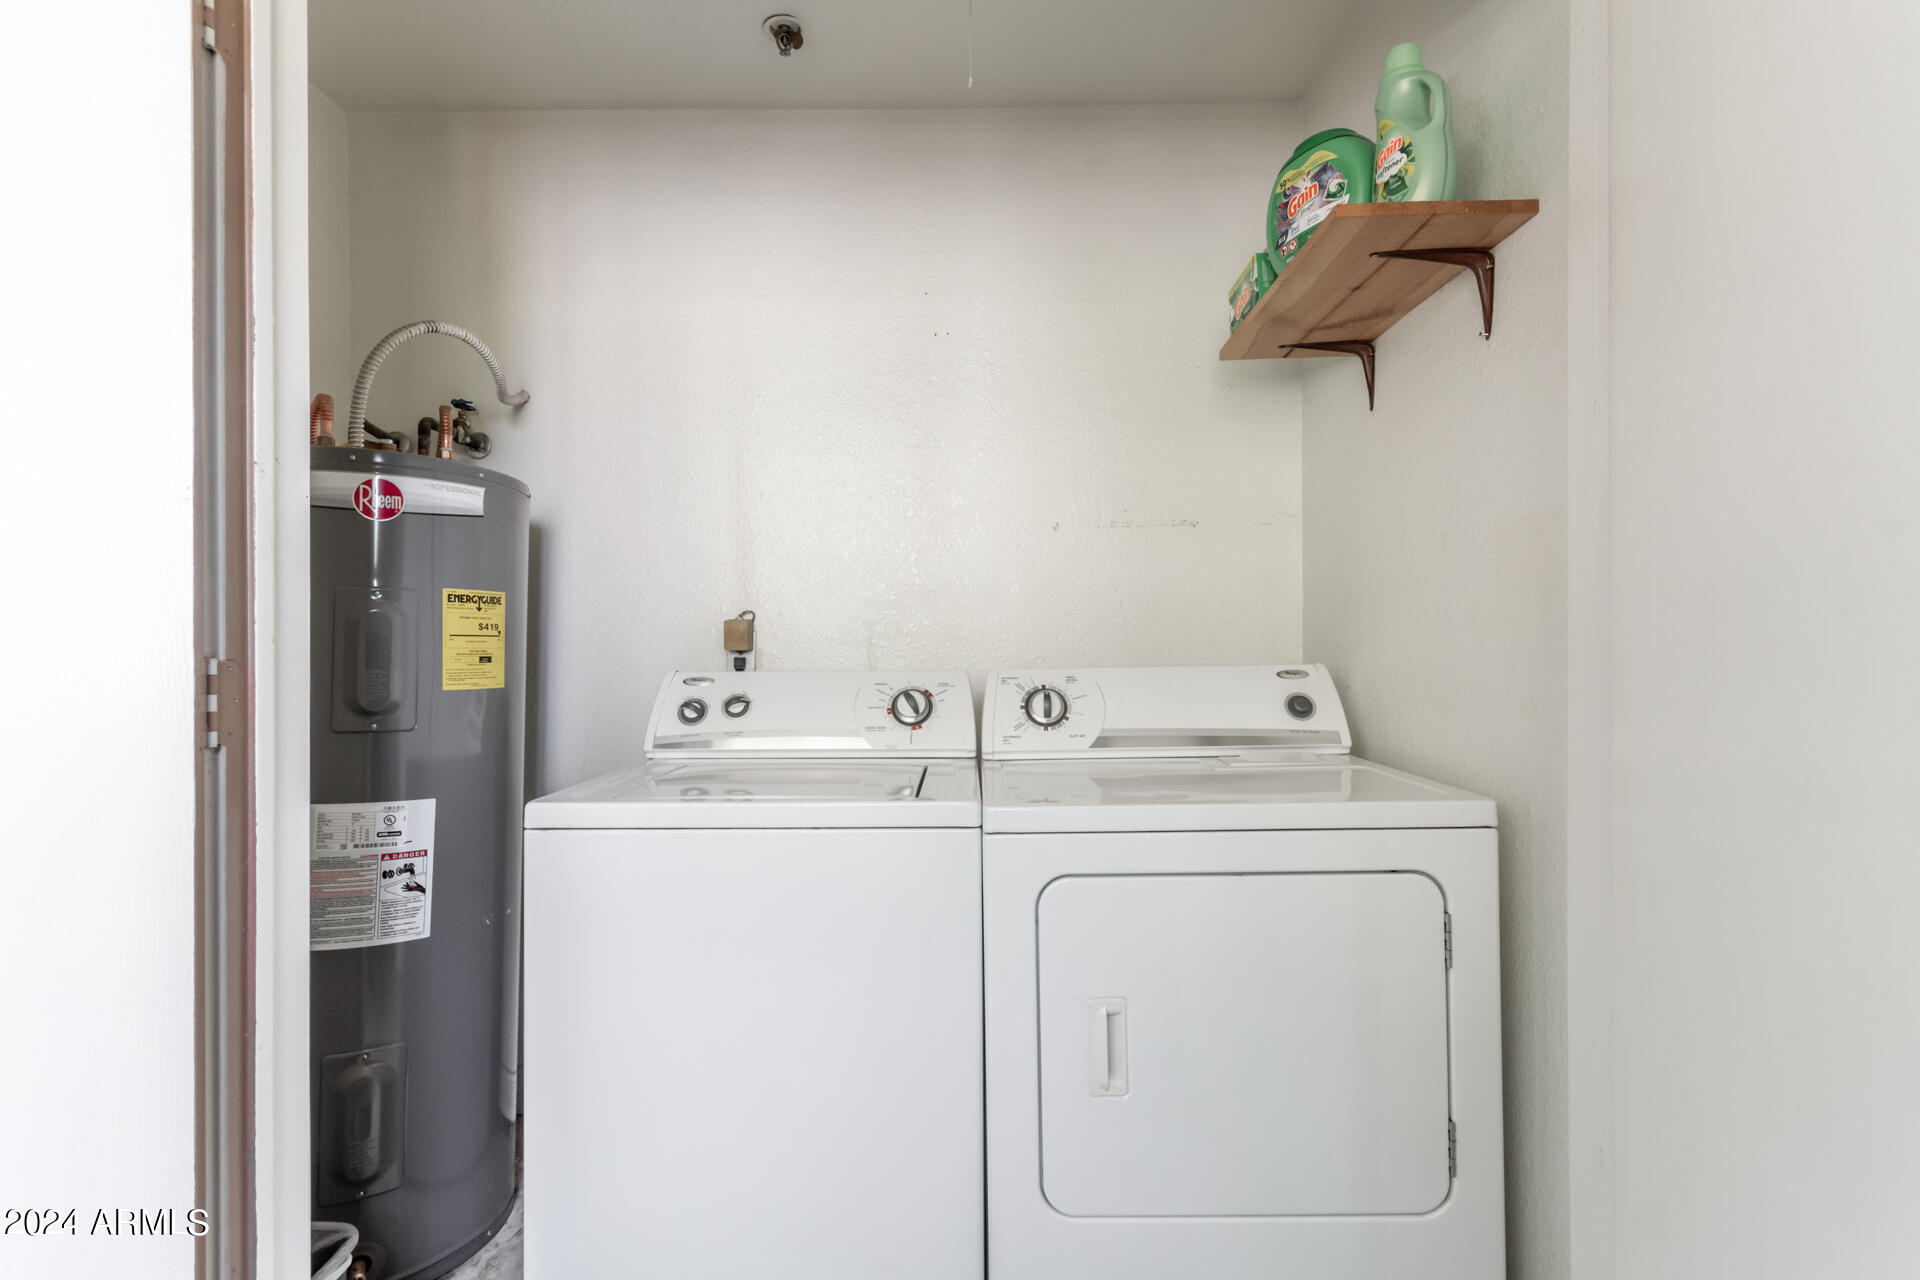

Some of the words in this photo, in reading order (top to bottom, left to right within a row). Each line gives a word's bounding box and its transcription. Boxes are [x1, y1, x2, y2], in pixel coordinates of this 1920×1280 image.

[1377, 137, 1403, 171] Gain
[1288, 182, 1319, 219] Gain
[447, 593, 502, 606] ENERGYGUIDE
[392, 850, 425, 859] DANGER
